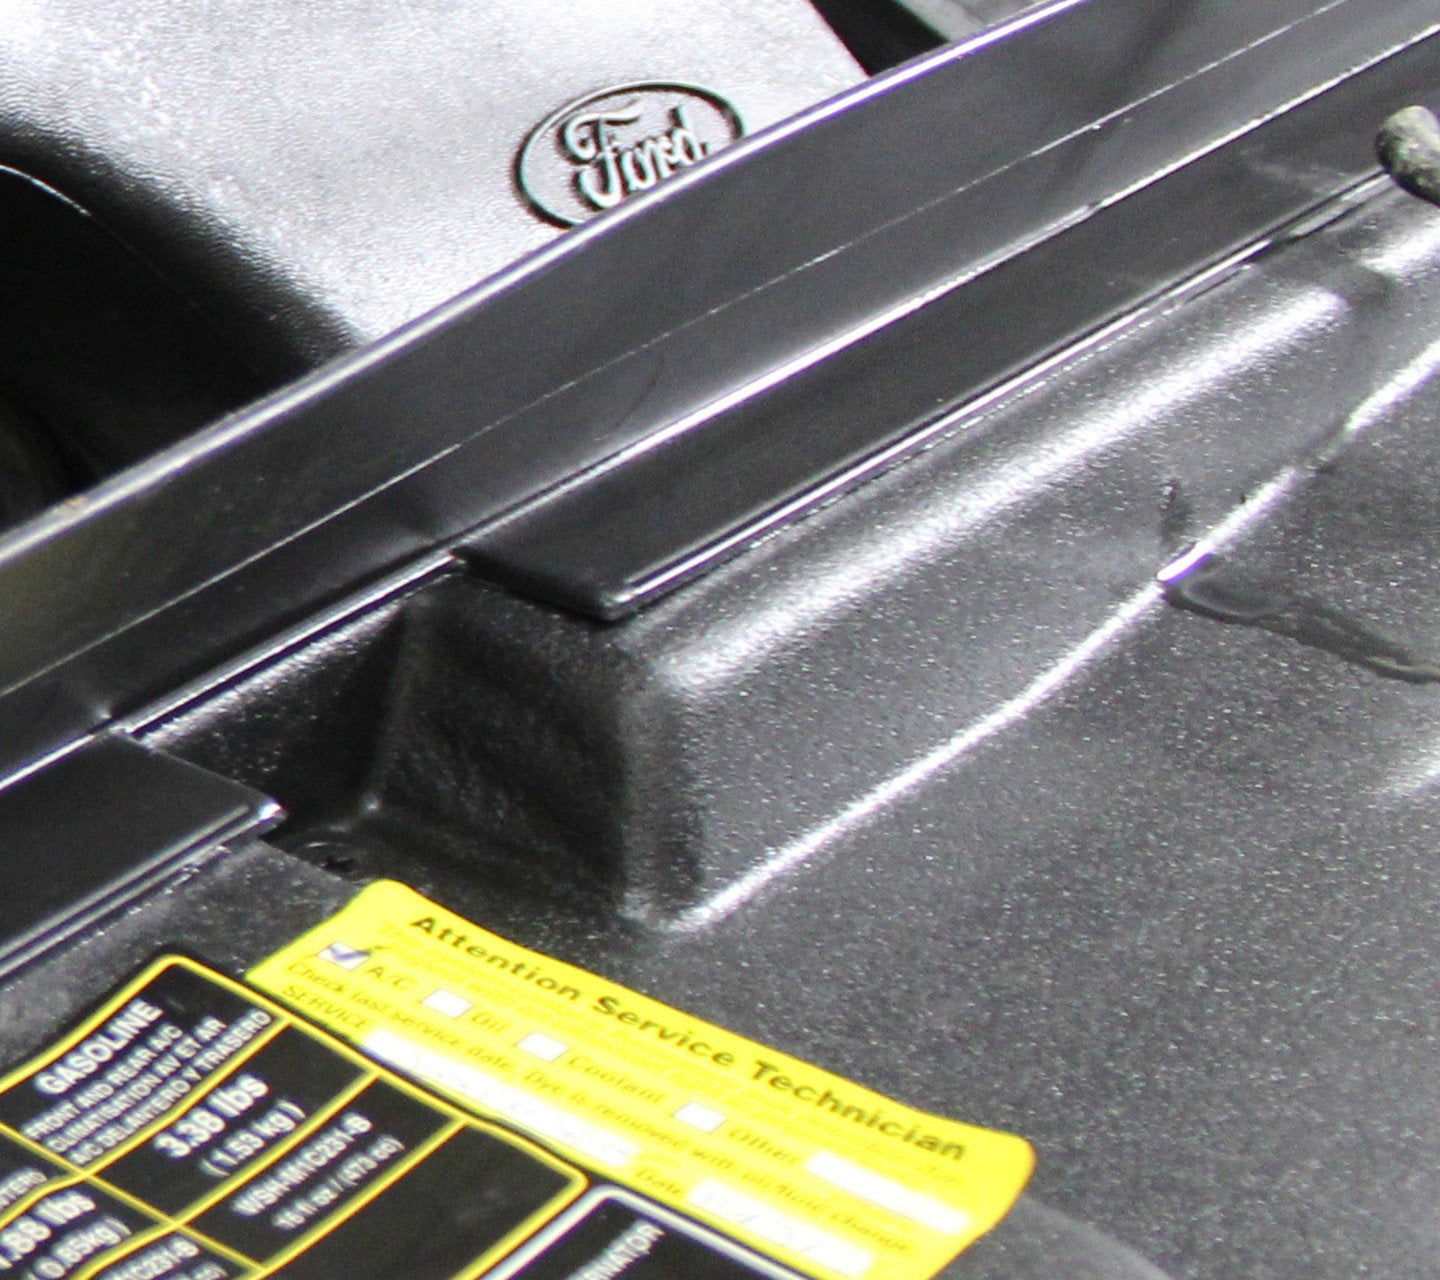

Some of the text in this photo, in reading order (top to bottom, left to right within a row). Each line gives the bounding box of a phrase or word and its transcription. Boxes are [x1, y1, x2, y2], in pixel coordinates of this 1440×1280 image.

[556, 98, 712, 214] Ford
[24, 1024, 188, 1137] FRONT AND REAR A/C
[28, 1000, 168, 1094] GASOLINE
[180, 1010, 269, 1068] TRASERO
[406, 915, 582, 1001] Attention
[590, 994, 735, 1068] Service
[750, 1059, 967, 1163] Technician
[47, 1074, 170, 1151] CLIMATISATION
[152, 1053, 180, 1077] AV
[173, 1036, 200, 1058] ET
[84, 1078, 189, 1146] DELANTERO
[155, 1074, 266, 1157] 3.38 lbs
[69, 1140, 102, 1164] A/C
[35, 1190, 94, 1225] lbs
